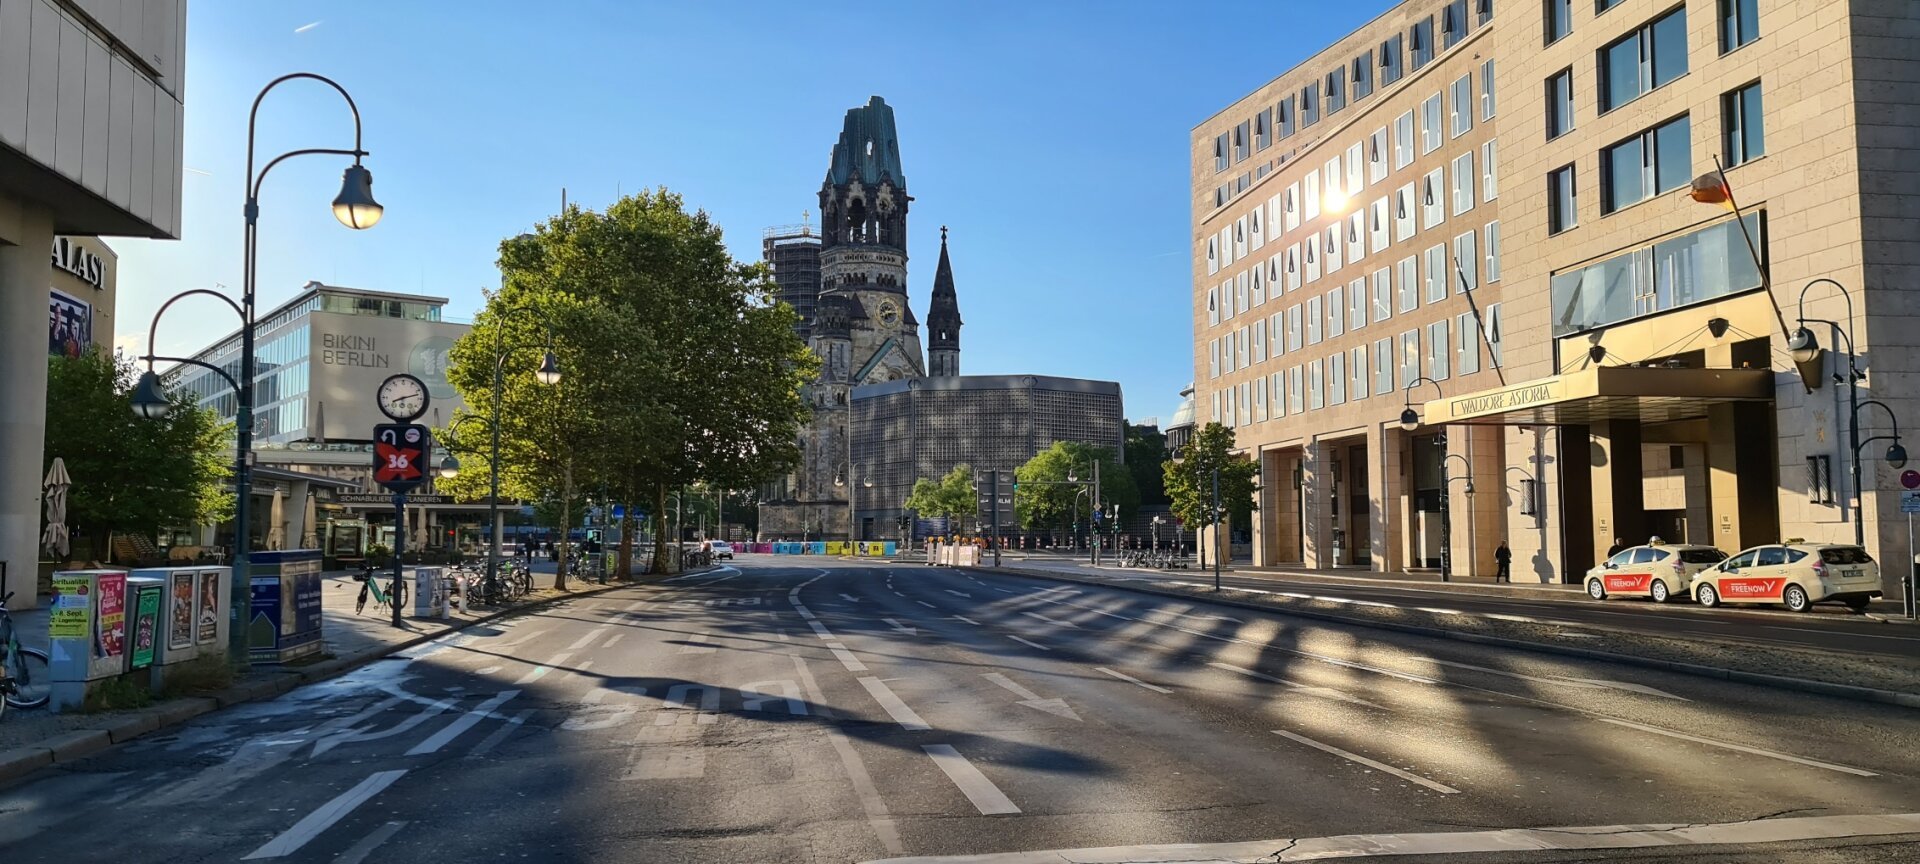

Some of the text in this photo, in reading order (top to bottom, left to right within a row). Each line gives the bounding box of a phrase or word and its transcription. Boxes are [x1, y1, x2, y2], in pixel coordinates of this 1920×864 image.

[51, 234, 106, 290] ALAST
[323, 333, 376, 351] BIKINI
[323, 350, 389, 368] BERLIN
[1461, 384, 1551, 414] WALDORF ASTORIA
[389, 454, 409, 469] 36
[340, 495, 393, 503] SCHNABULIERE
[1731, 585, 1766, 593] FREENOW
